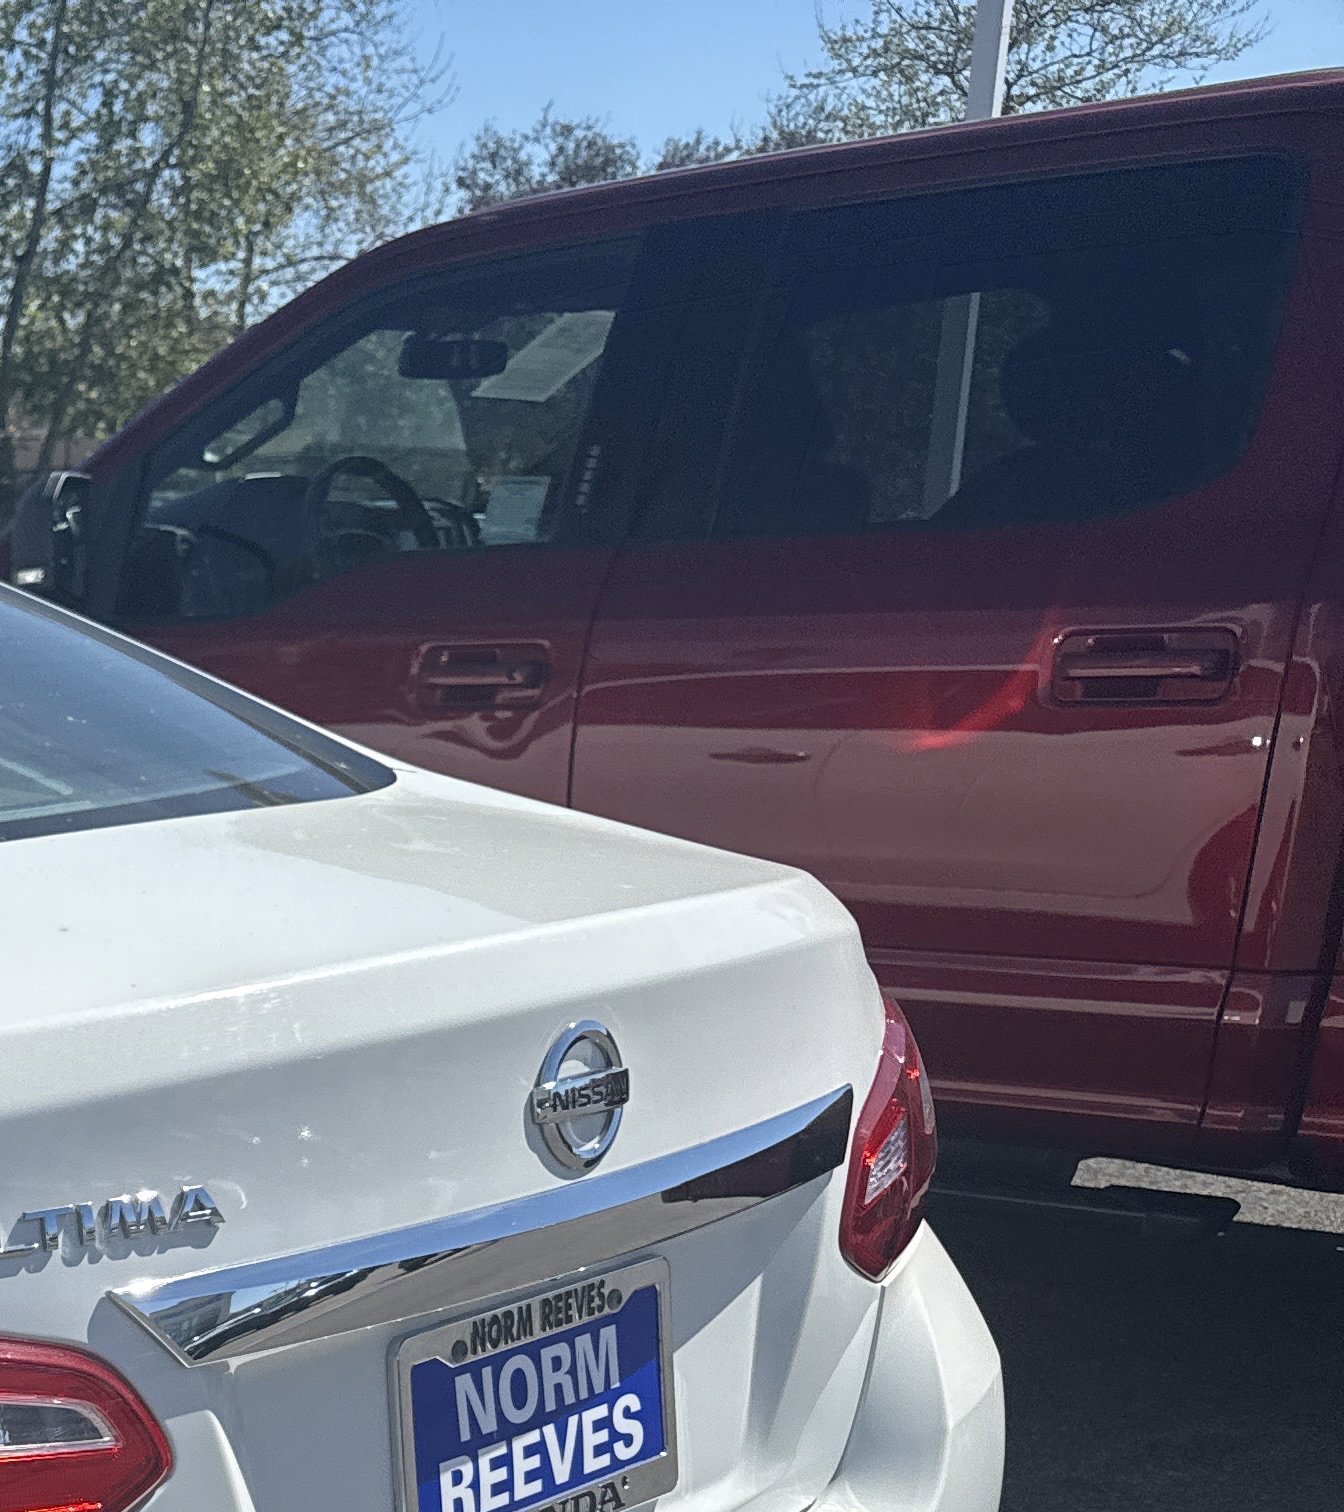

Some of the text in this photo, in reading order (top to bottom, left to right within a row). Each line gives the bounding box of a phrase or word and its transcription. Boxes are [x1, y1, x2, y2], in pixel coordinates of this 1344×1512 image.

[551, 1070, 628, 1113] NISSAN
[470, 1279, 606, 1356] NORM REEVES
[454, 1324, 621, 1442] NORM
